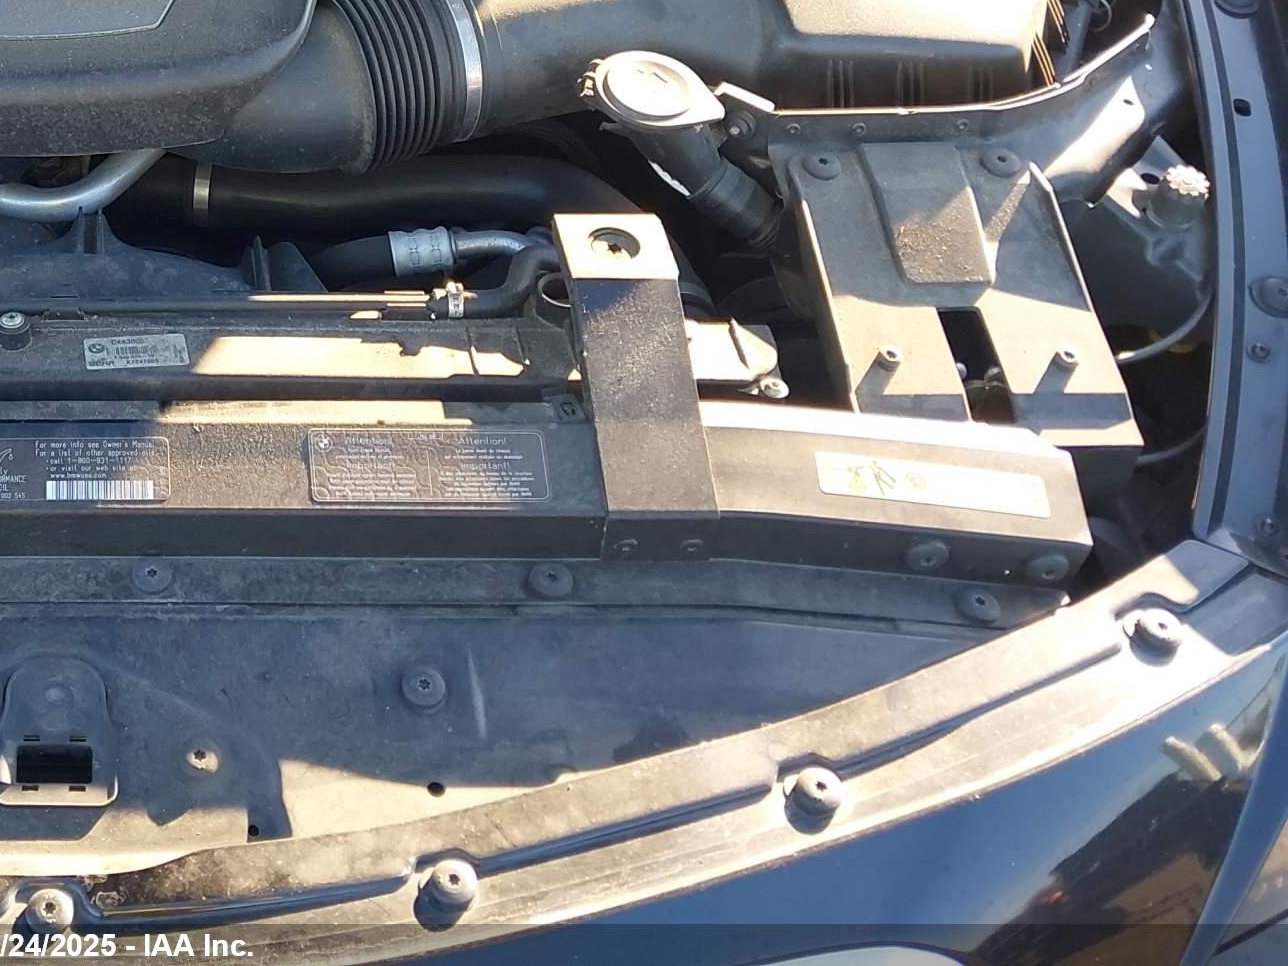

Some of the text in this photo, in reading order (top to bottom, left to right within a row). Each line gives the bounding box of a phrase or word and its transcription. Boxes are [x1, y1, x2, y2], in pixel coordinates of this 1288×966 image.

[35, 440, 46, 449] For
[103, 440, 128, 448] Owner's
[458, 437, 506, 446] Attention!
[35, 448, 46, 457] For
[108, 449, 138, 458] approved
[461, 462, 510, 470] Important!
